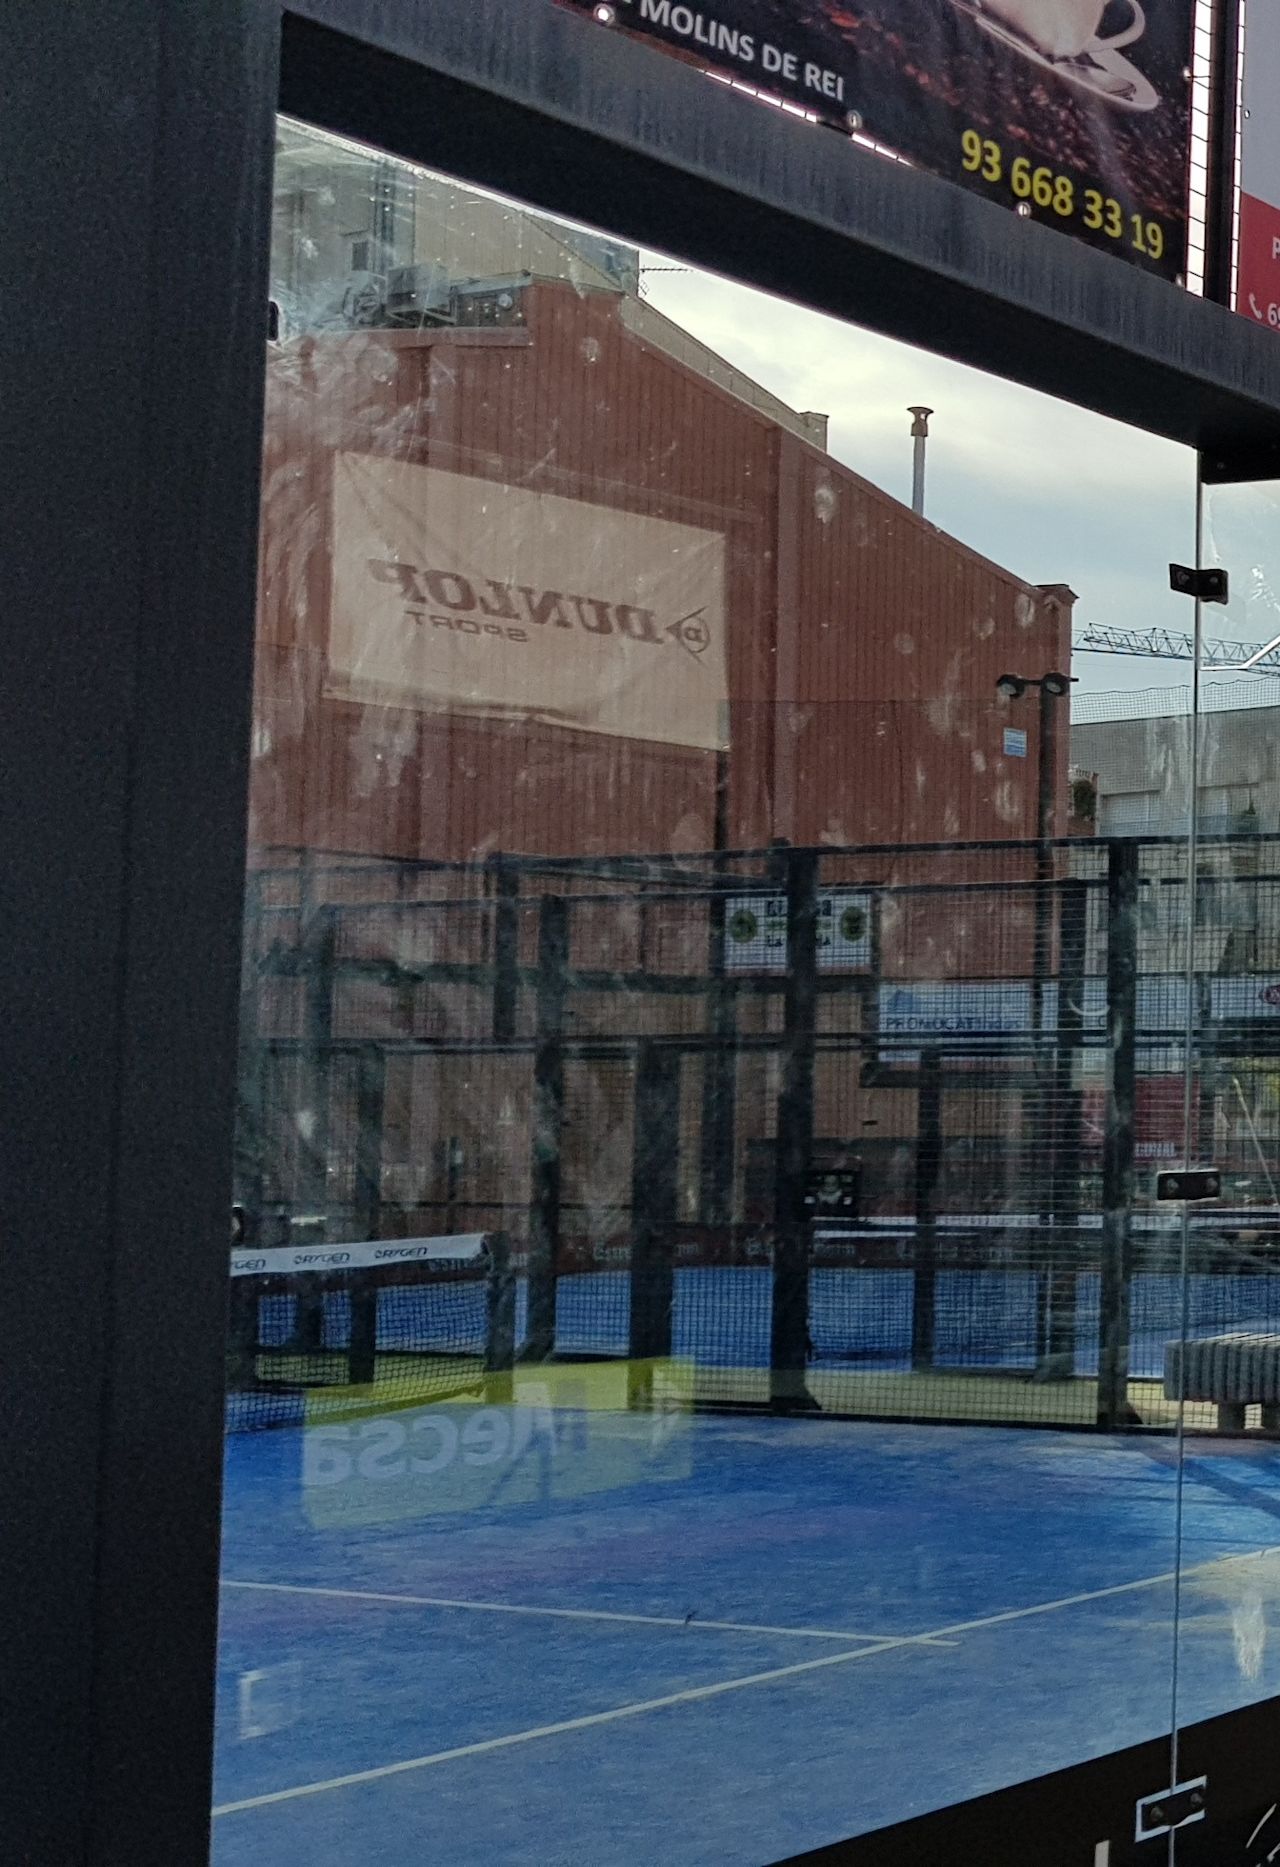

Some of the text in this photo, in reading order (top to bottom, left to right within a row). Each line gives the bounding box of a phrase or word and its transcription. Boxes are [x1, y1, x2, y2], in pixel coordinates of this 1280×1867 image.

[640, 0, 844, 101] MOLINS DE REI
[961, 129, 1163, 259] 93 668 33 19
